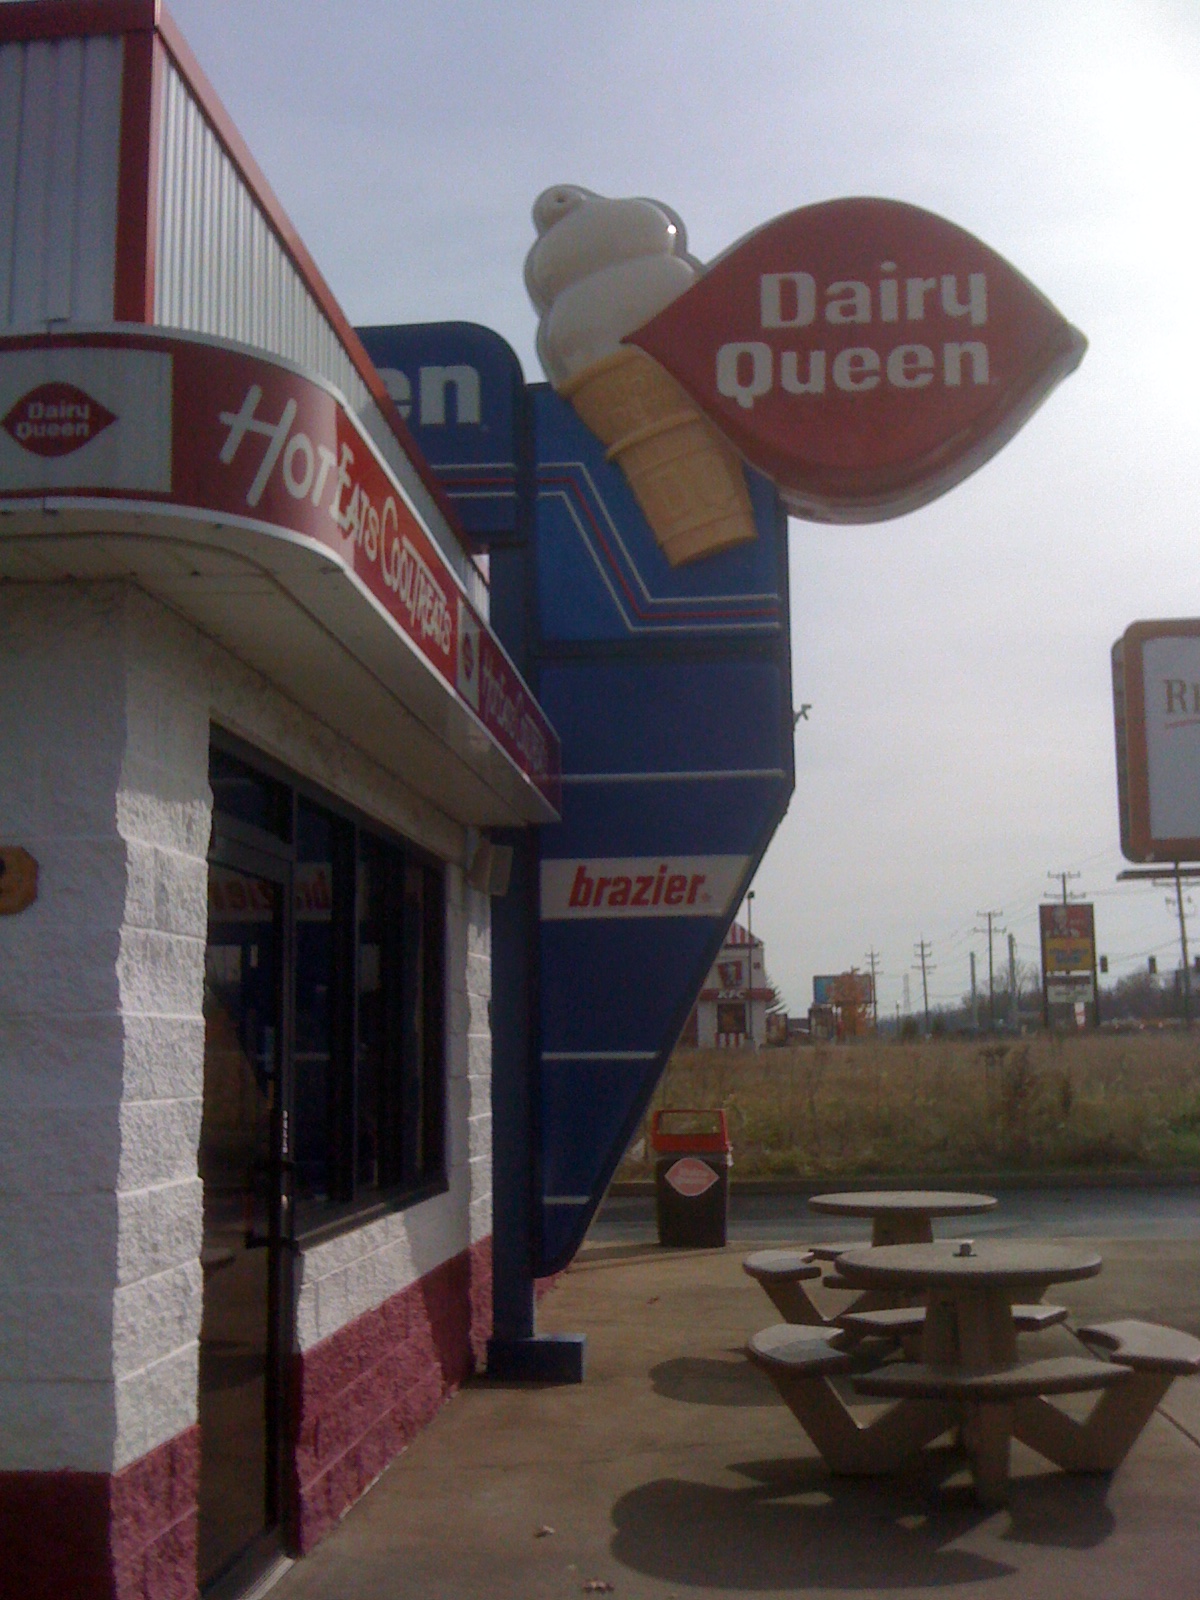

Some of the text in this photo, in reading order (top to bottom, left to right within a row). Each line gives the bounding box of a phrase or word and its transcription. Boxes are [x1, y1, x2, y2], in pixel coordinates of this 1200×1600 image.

[760, 260, 988, 328] Dairy
[715, 341, 990, 408] Queen
[27, 400, 90, 419] Dairy
[16, 421, 90, 440] Queen
[568, 864, 706, 907] brazier
[717, 989, 746, 999] KFC
